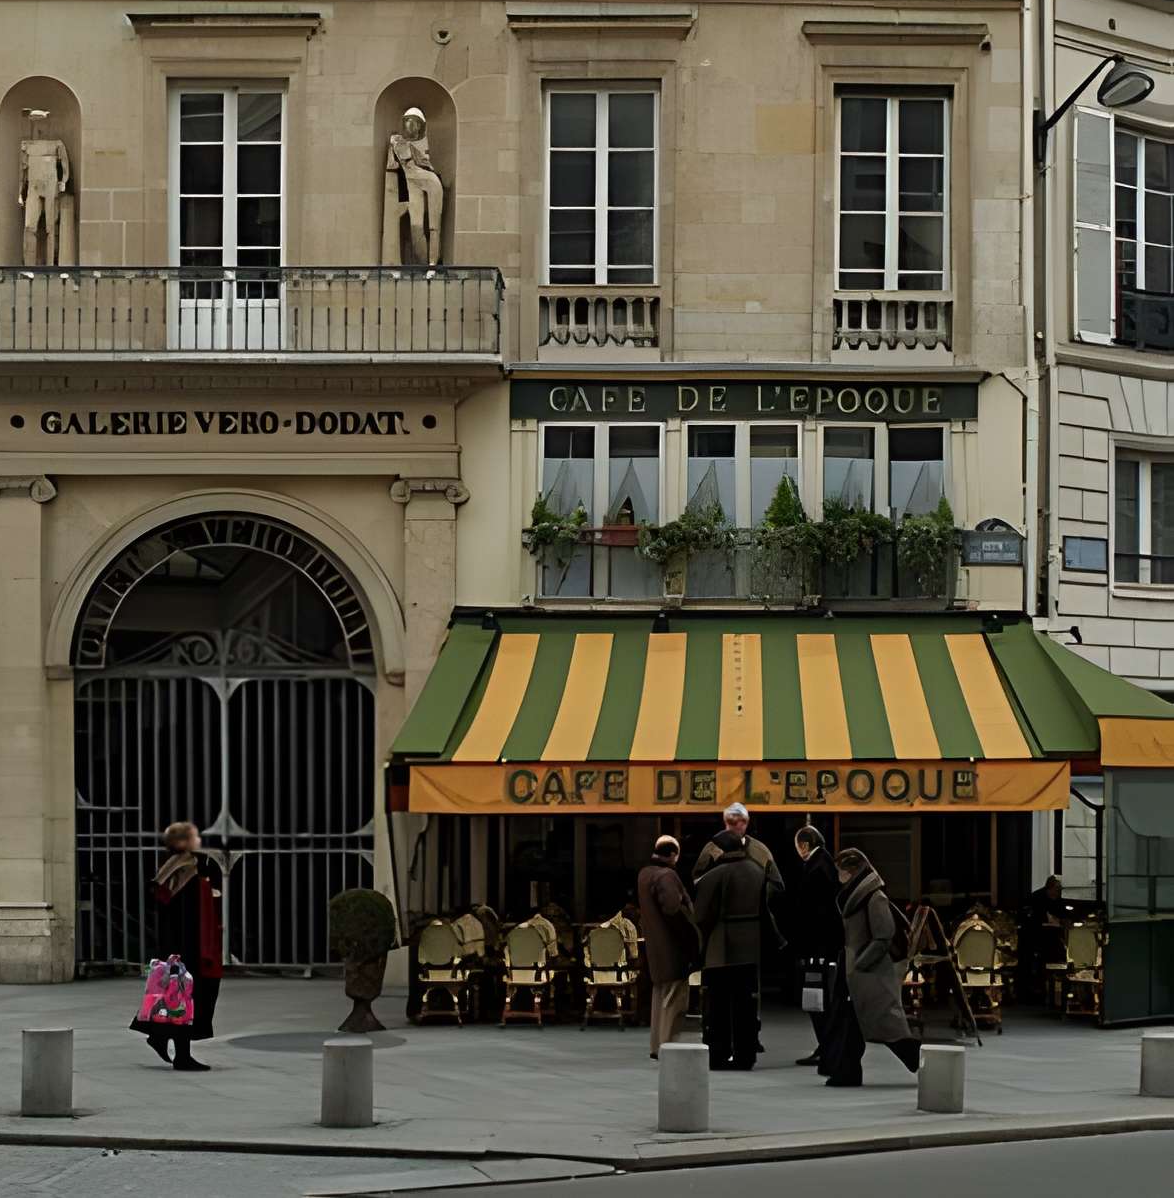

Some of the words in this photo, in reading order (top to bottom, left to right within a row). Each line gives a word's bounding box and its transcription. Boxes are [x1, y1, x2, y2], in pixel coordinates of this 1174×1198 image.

[549, 385, 646, 413] CAFE
[677, 385, 727, 412] DE
[757, 385, 943, 415] L'EPOQUE
[40, 410, 188, 436] GALERIE
[508, 768, 628, 804] CAFE
[655, 768, 717, 802] DE
[743, 768, 975, 805] L'EPOQUE
